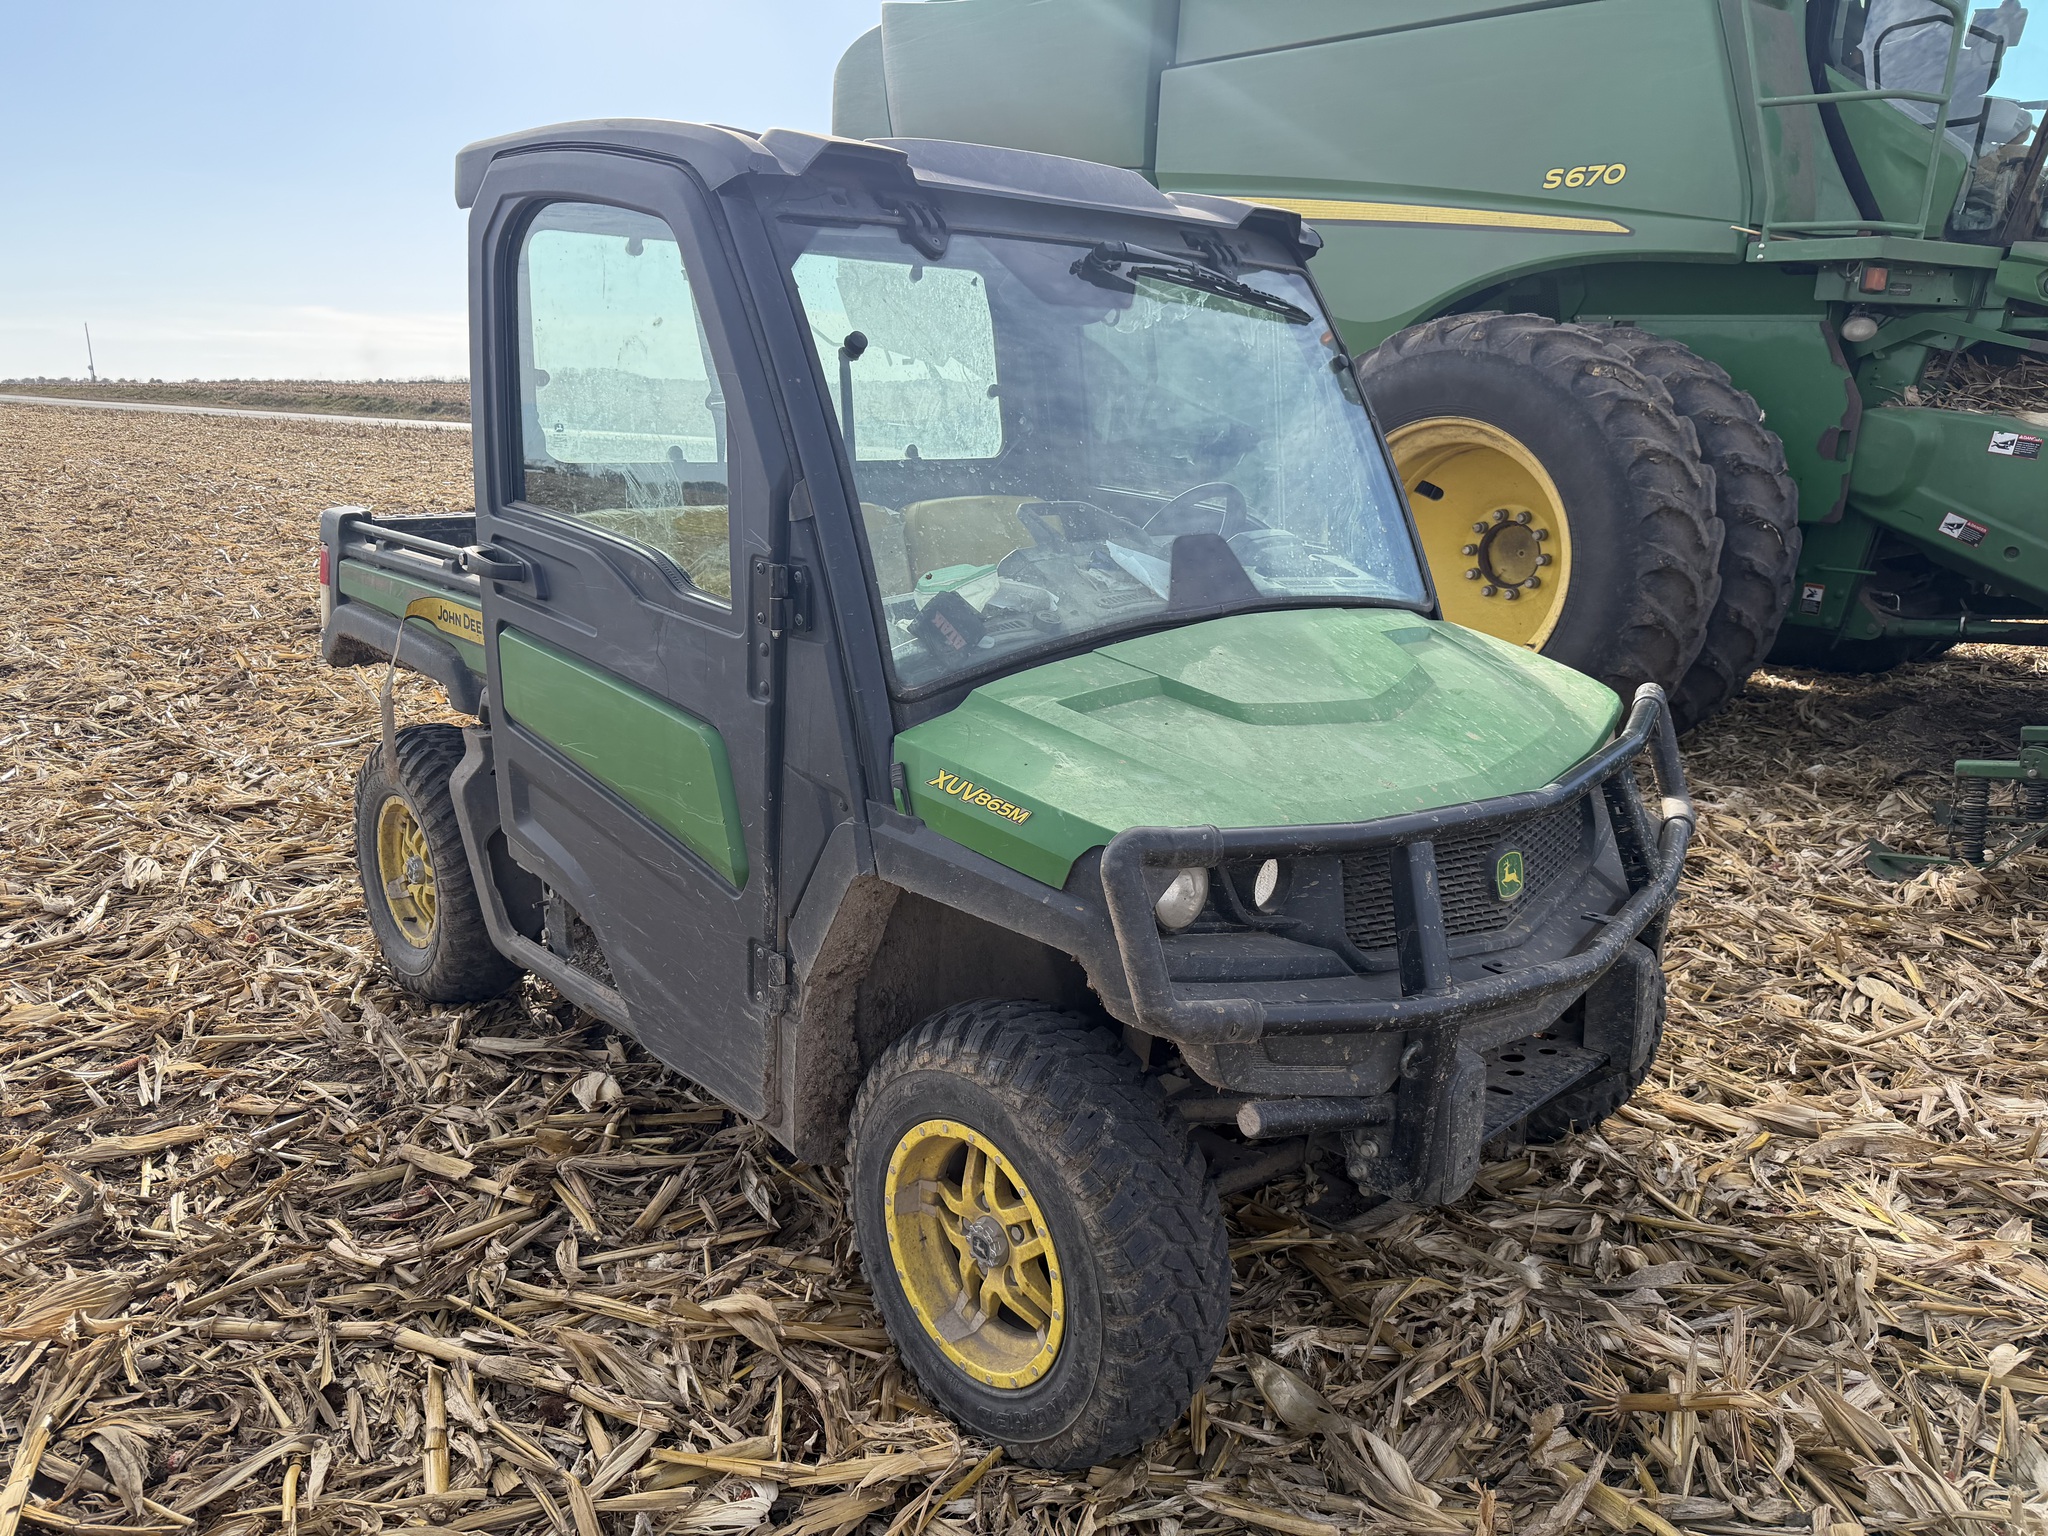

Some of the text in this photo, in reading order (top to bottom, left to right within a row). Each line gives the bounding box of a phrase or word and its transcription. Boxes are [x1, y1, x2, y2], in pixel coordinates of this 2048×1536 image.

[1542, 162, 1627, 190] S670
[437, 605, 462, 627] JOHN
[928, 769, 1031, 824] XUV865M
